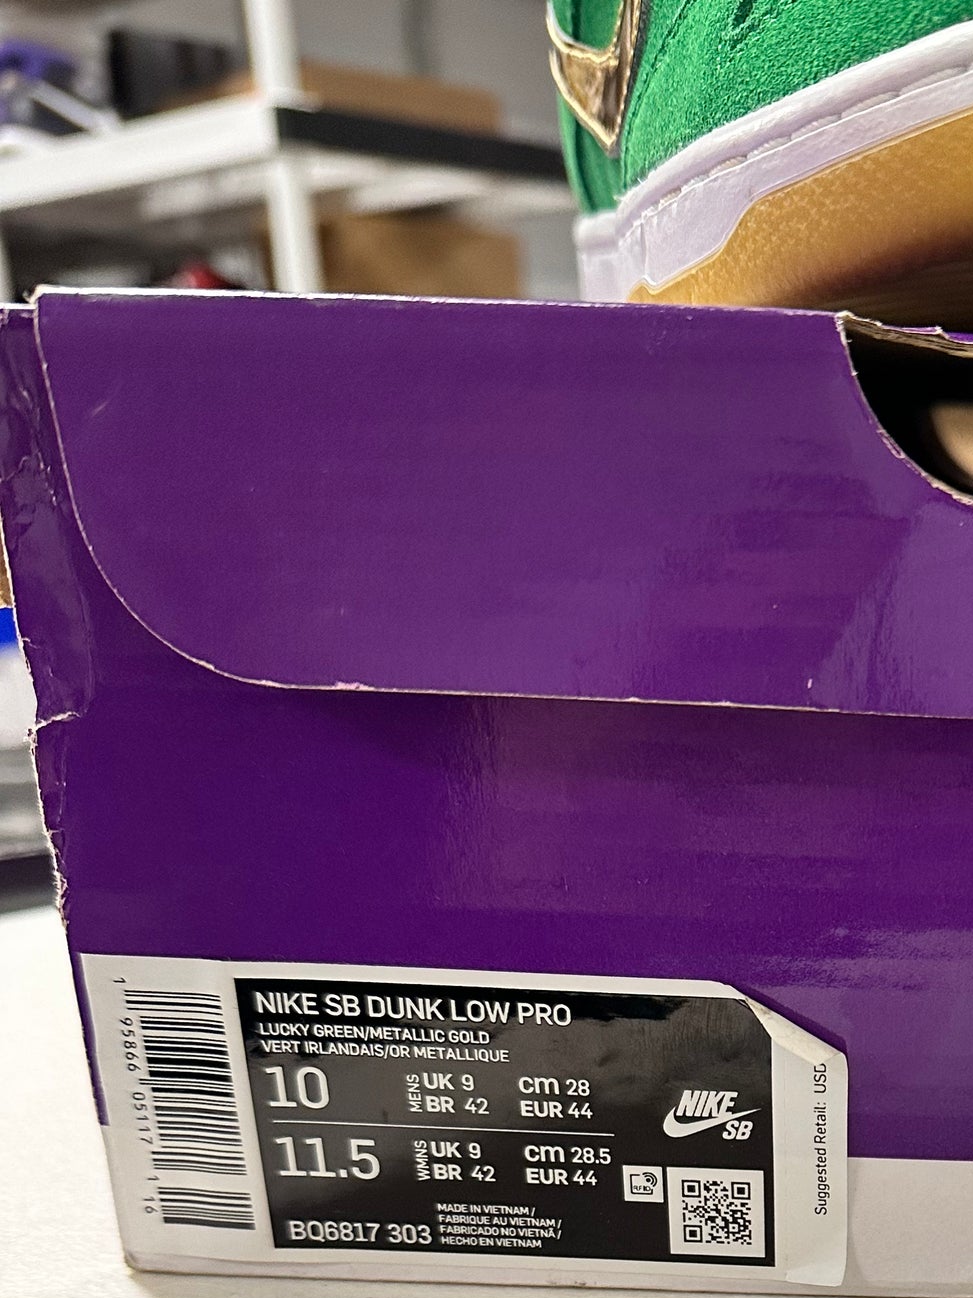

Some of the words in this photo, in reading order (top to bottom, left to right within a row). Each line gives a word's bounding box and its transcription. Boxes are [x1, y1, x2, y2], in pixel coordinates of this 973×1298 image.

[255, 991, 320, 1015] NIKE
[324, 993, 361, 1017] SB
[367, 995, 445, 1020] DUNK
[450, 999, 510, 1024] LOW
[517, 1002, 572, 1026] PRO
[259, 1022, 309, 1036] LUCKY
[313, 1024, 445, 1042] GREEN/METALLIC
[449, 1030, 490, 1044] GOLD
[261, 1040, 300, 1053] VERT
[304, 1041, 410, 1059] IRLANDAIS/OR
[414, 1046, 510, 1062] METALLIQUE
[120, 1017, 141, 1072] 95866
[132, 1092, 153, 1144] 05117
[265, 1065, 330, 1109] 10
[423, 1072, 455, 1090] UK
[462, 1074, 475, 1091] 9
[565, 1079, 591, 1096] 28
[406, 1074, 423, 1112] MENS
[675, 1089, 739, 1118] NIKE
[425, 1095, 455, 1113] BR
[464, 1098, 489, 1115] 42
[520, 1100, 564, 1118] EUR
[567, 1102, 593, 1119] 44
[722, 1120, 754, 1141] SB
[814, 1102, 827, 1144] Retail:
[274, 1136, 381, 1180] 11.5
[414, 1140, 431, 1181] WMNS
[431, 1141, 462, 1158] UK
[469, 1142, 481, 1159] 9
[570, 1147, 612, 1165] 28.5
[433, 1163, 463, 1180] BR
[471, 1165, 496, 1182] 42
[526, 1168, 569, 1185] EUR
[573, 1170, 597, 1186] 44
[814, 1148, 830, 1215] Suggested
[437, 1203, 468, 1213] MADE
[470, 1205, 481, 1213] IN
[482, 1205, 529, 1215] VIETNAM
[438, 1214, 490, 1225] FABRIQUE
[493, 1217, 508, 1225] AU
[509, 1217, 556, 1227] VIETNAM
[439, 1225, 499, 1236] FABRICADO
[500, 1227, 517, 1236] NO
[289, 1220, 378, 1243] BQ6817
[388, 1225, 432, 1245] 303
[441, 1236, 478, 1246] HECHO
[480, 1237, 494, 1246] EN
[496, 1238, 542, 1248] VIETNAM
